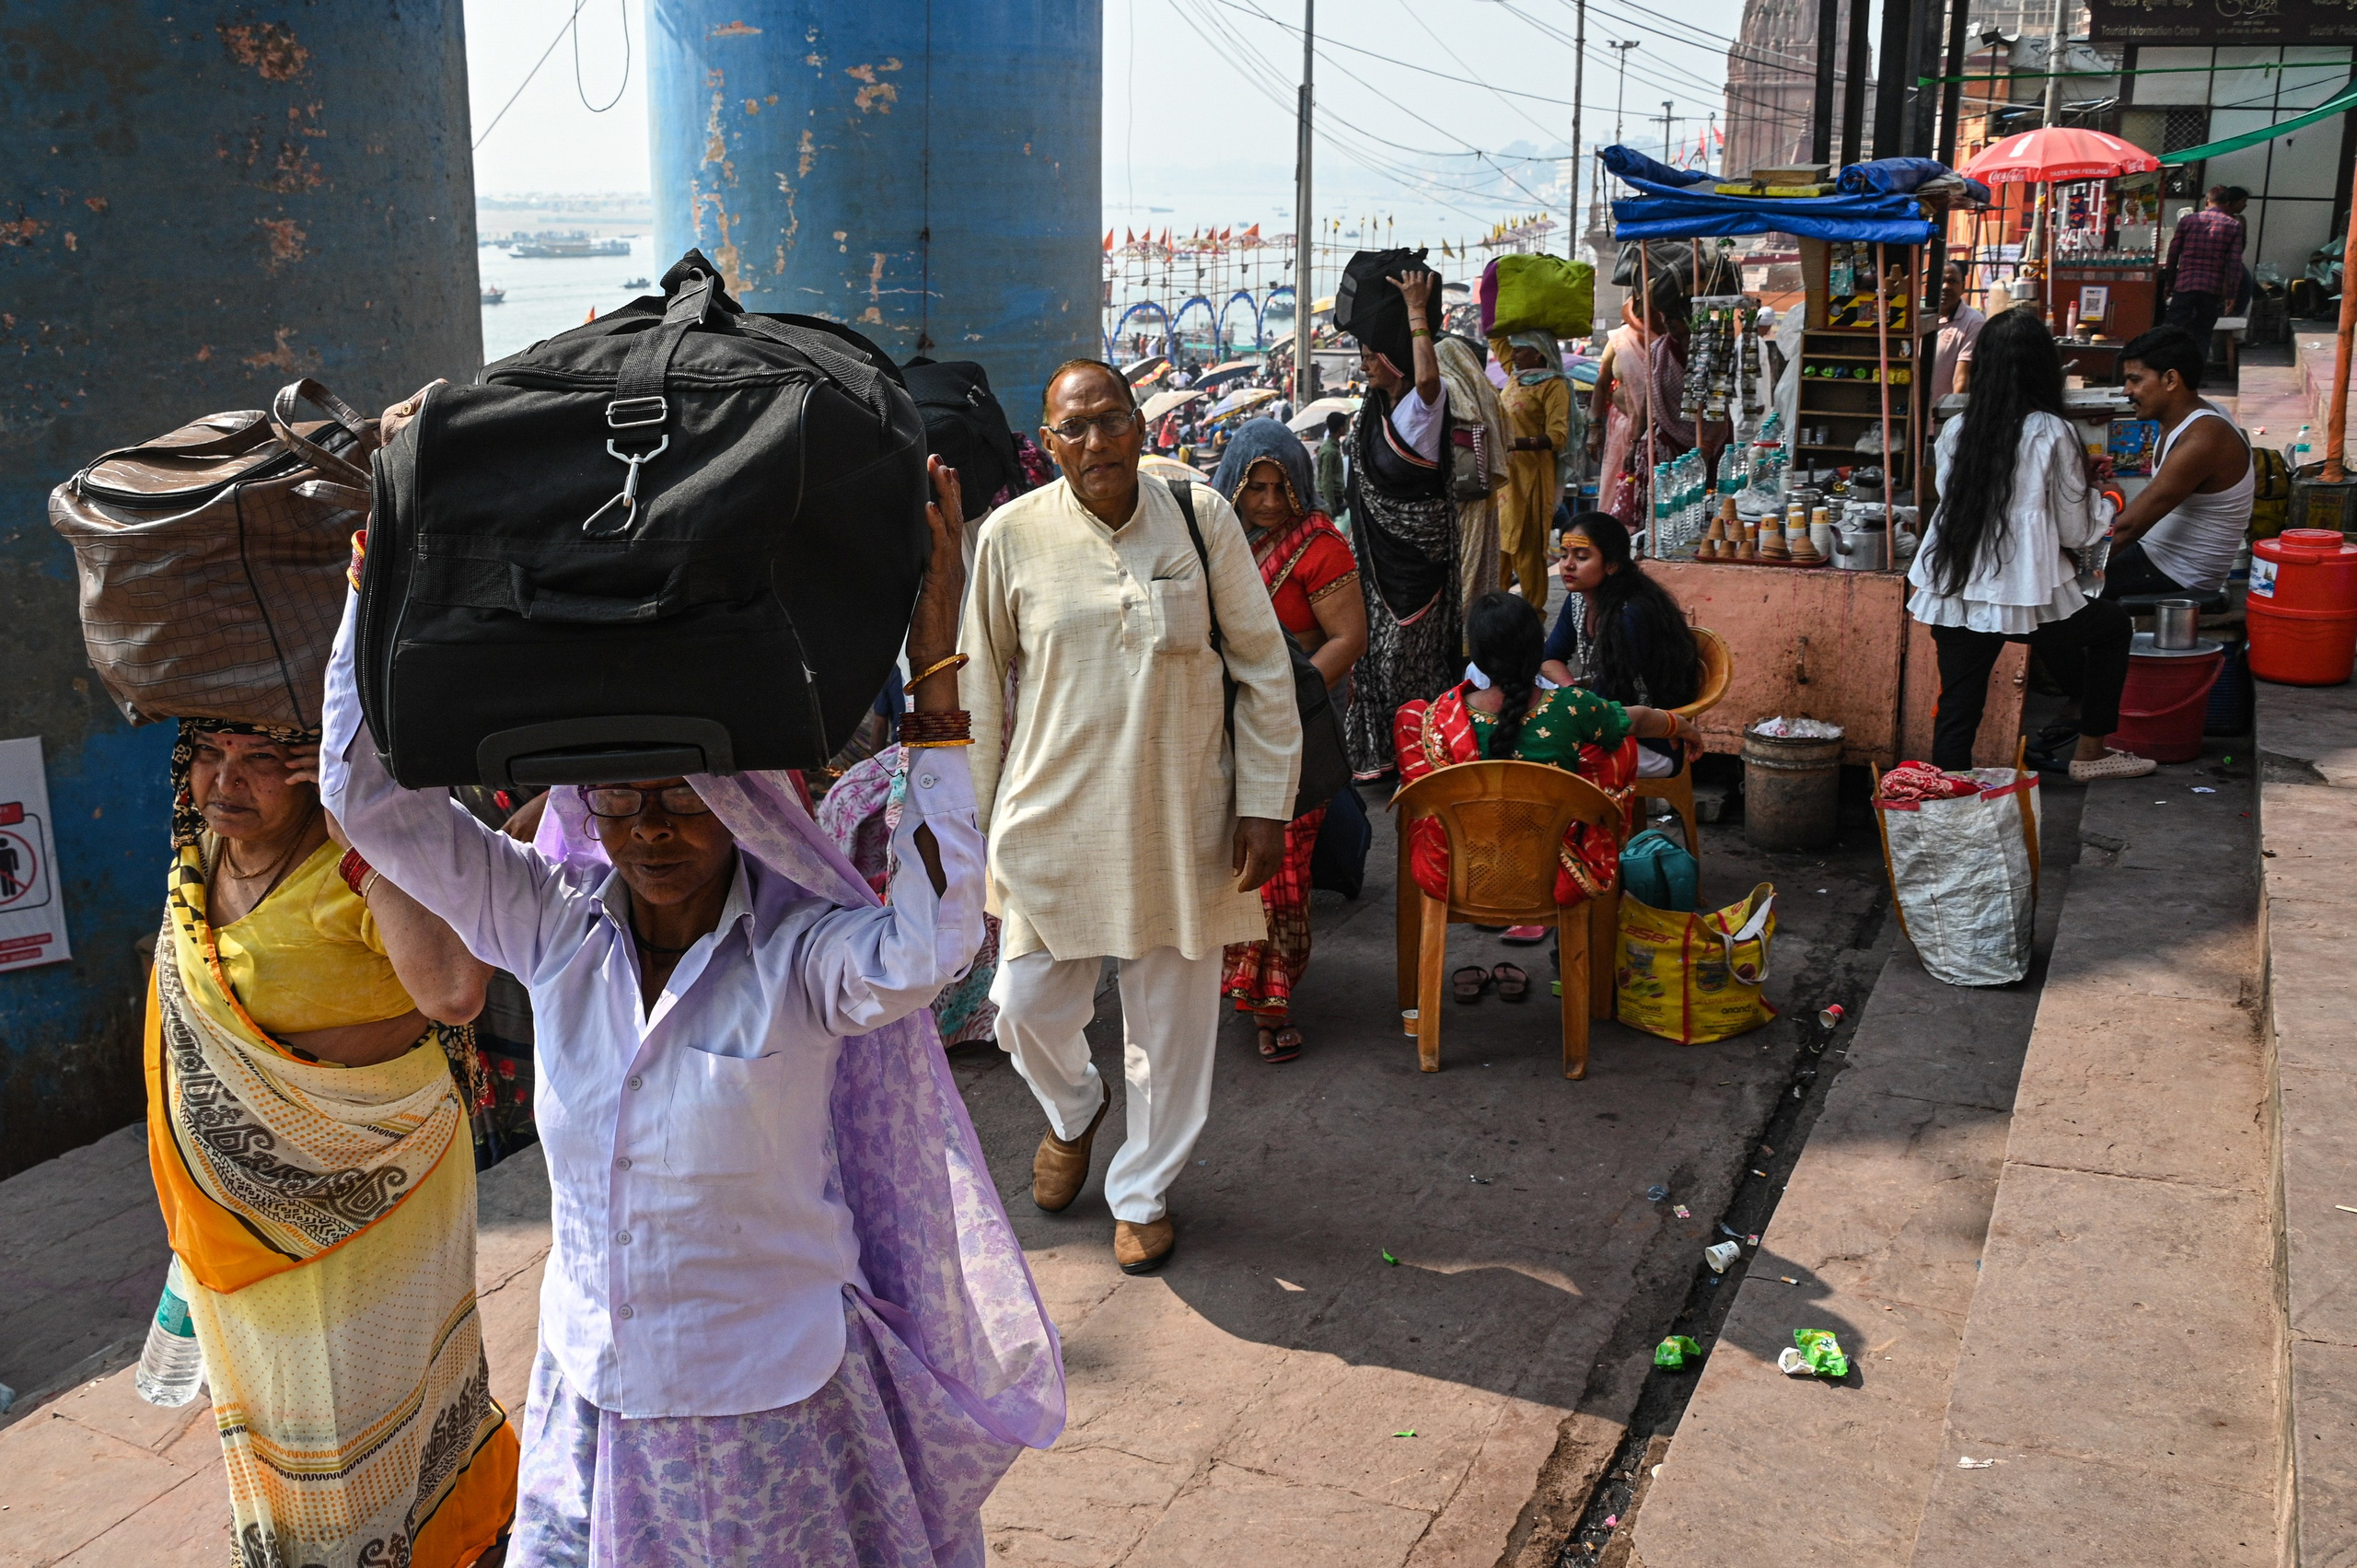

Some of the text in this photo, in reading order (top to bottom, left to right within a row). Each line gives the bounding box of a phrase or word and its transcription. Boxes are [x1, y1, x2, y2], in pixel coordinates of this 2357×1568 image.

[2101, 25, 2200, 36] Tourist Information Centre
[1988, 168, 2026, 184] Coca-Cola
[1721, 1004, 1751, 1015] anand
